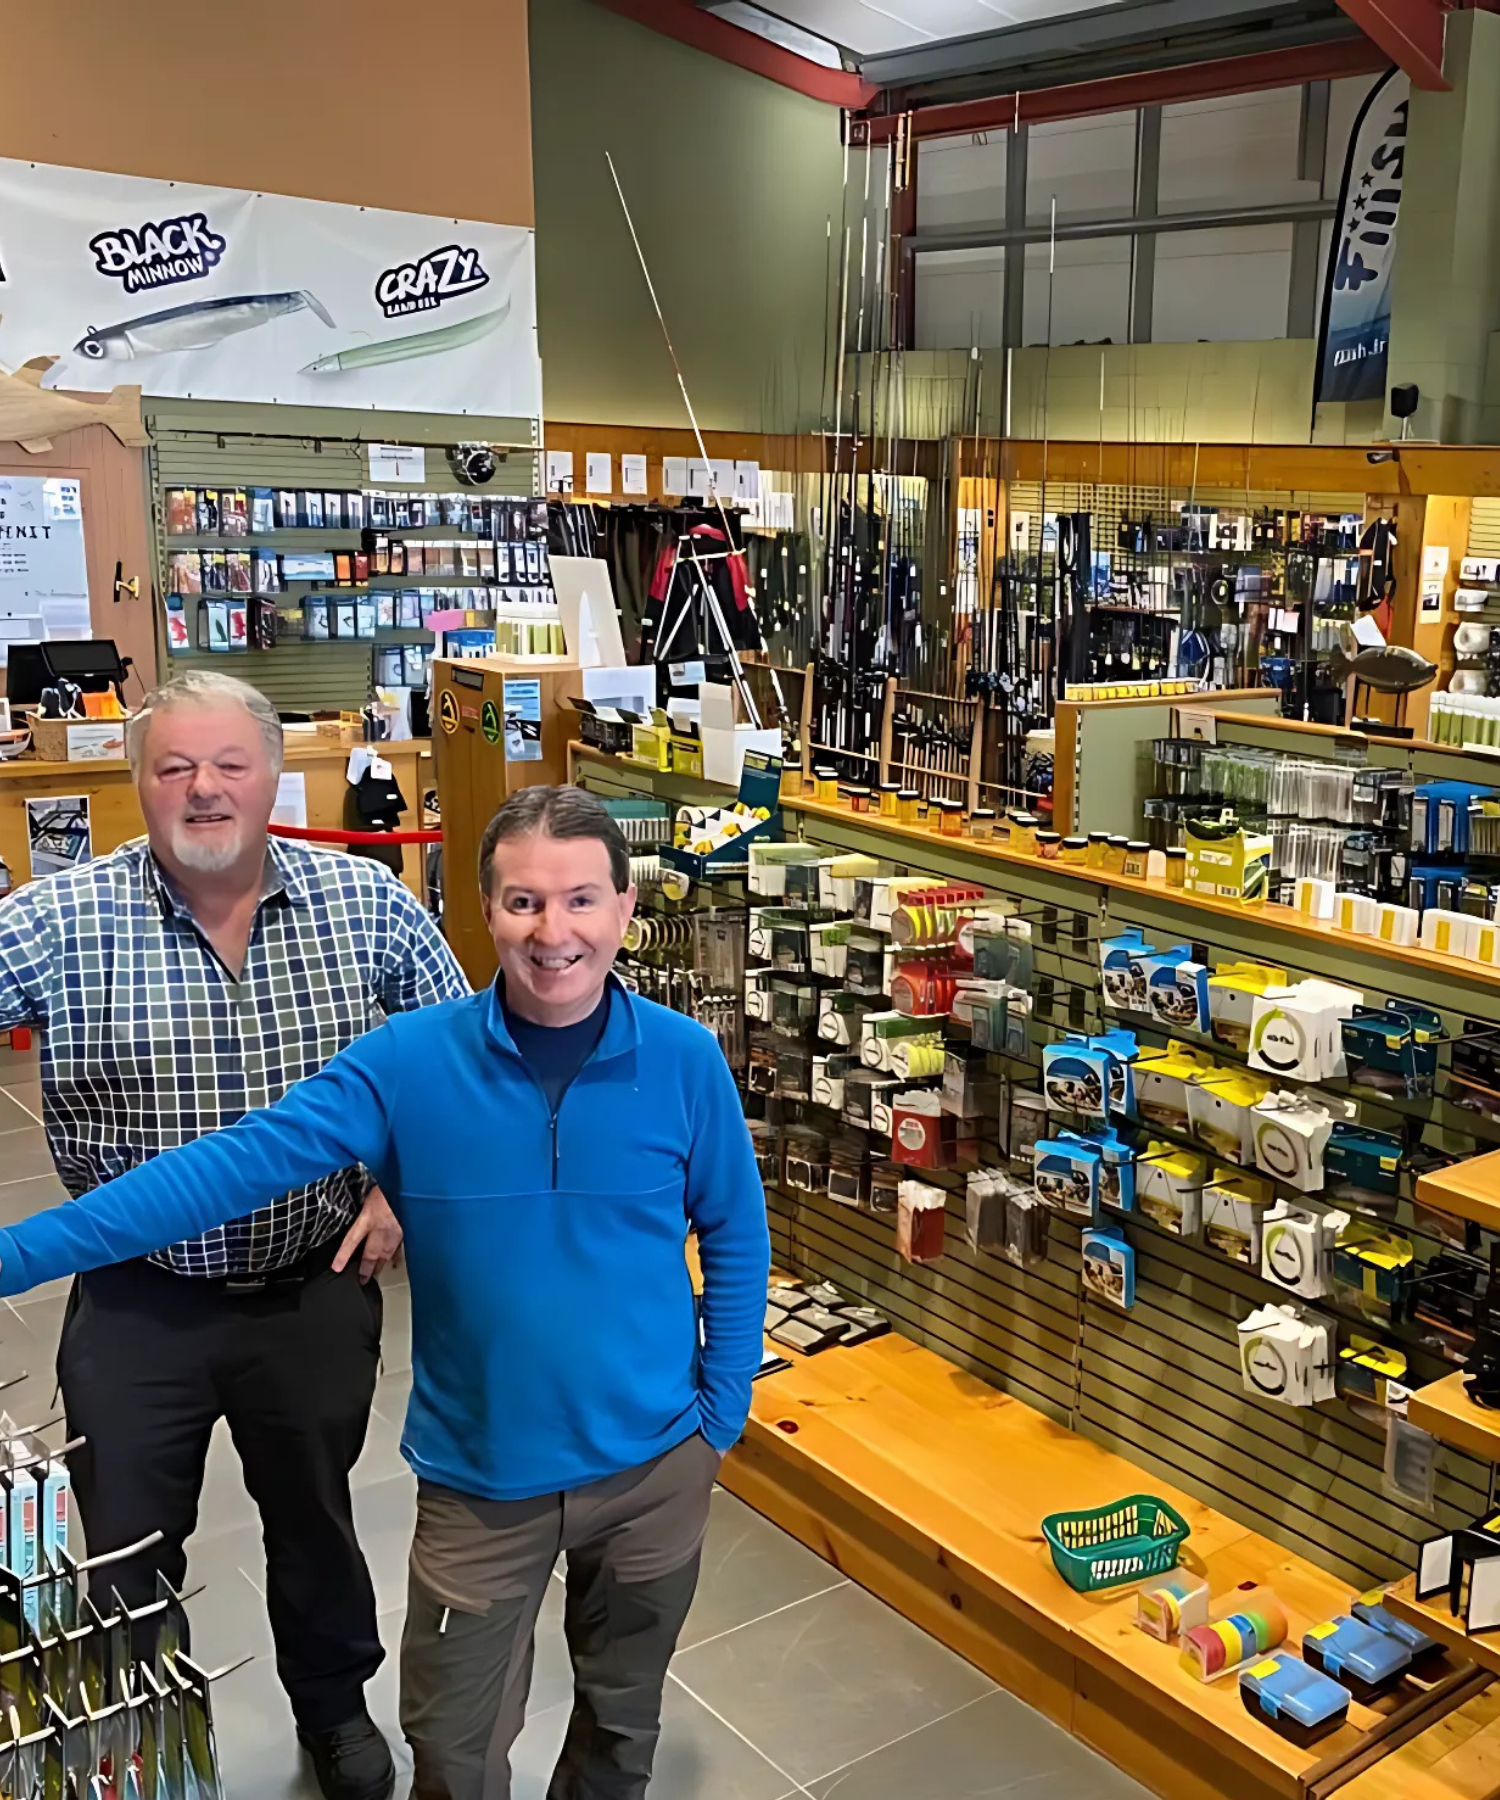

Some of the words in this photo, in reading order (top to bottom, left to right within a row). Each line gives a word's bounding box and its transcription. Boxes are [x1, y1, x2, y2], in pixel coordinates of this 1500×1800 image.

[93, 218, 221, 271] BLACK
[127, 256, 204, 289] MINNOW
[379, 249, 487, 303] CRAZY
